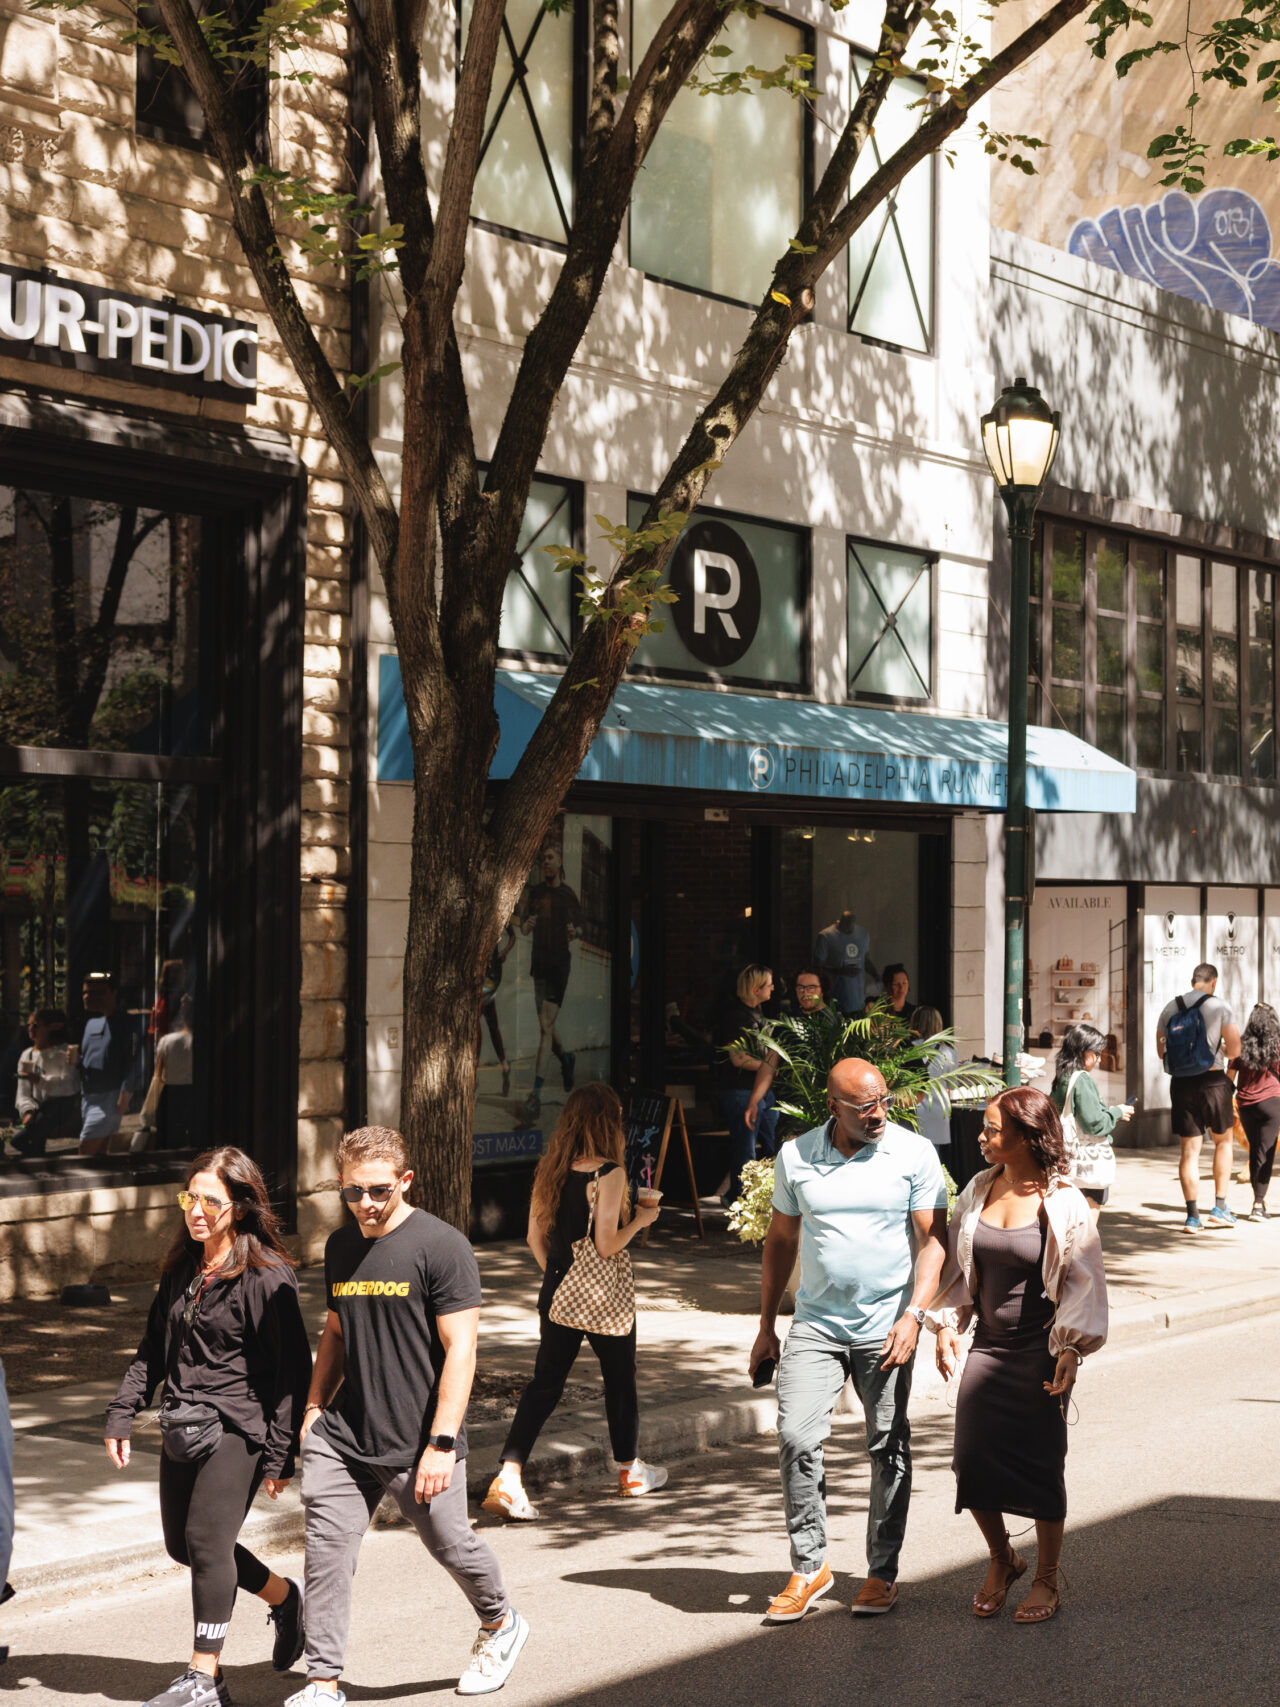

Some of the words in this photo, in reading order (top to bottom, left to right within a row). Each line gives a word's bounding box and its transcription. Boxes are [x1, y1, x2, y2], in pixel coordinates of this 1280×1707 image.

[694, 548, 741, 639] R
[785, 757, 930, 793] PHILADELPHIA
[1048, 896, 1112, 909] AVAILABLE
[1155, 946, 1186, 957] METRO
[1216, 946, 1245, 955] METRO
[496, 1135, 526, 1153] MAX
[529, 1134, 537, 1150] 2
[332, 1281, 410, 1297] UNDERDOG
